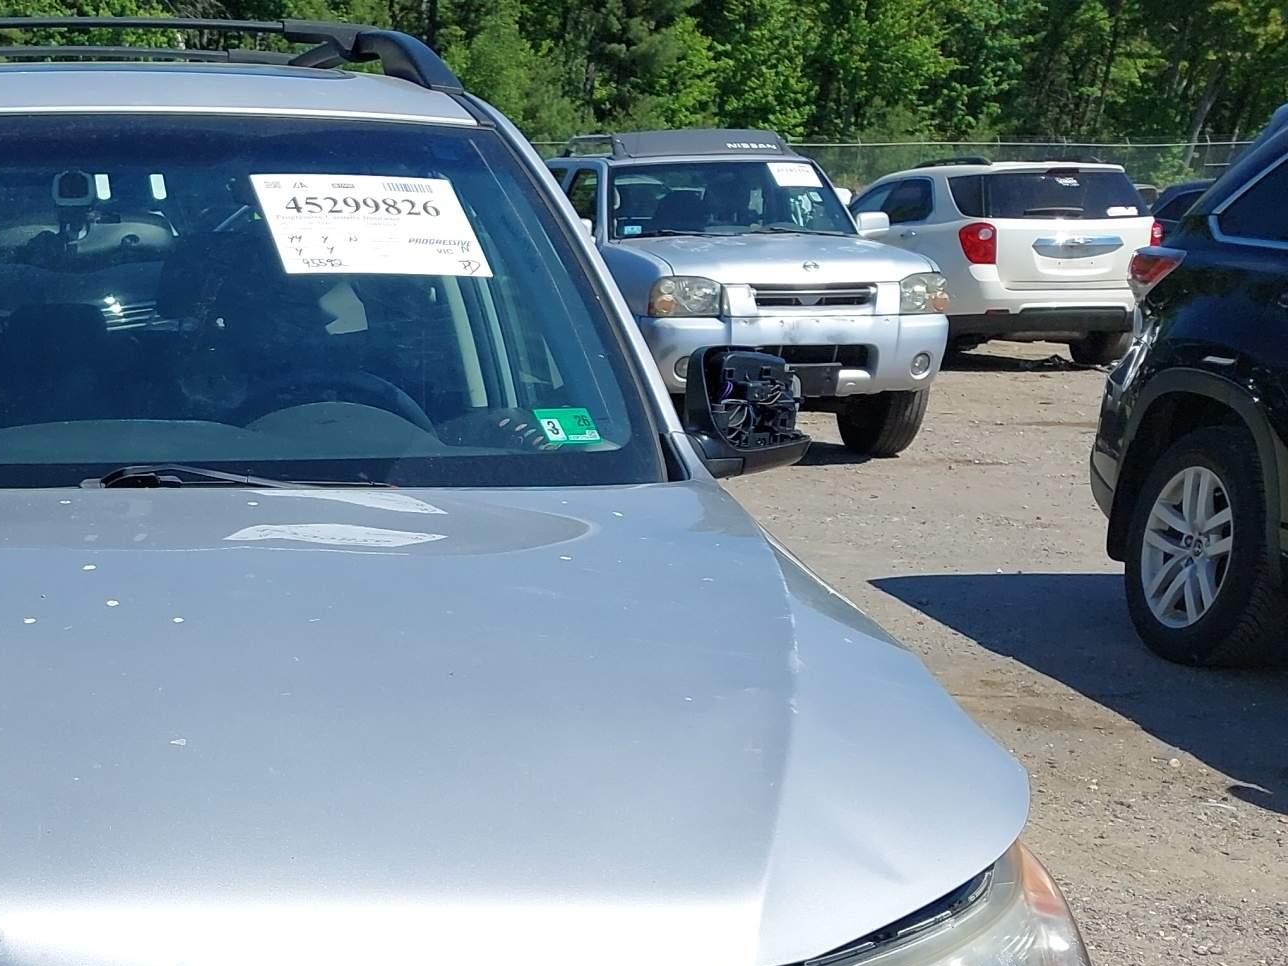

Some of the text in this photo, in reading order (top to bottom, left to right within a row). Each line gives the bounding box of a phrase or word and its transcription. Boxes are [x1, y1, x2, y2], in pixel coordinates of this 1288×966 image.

[725, 142, 777, 150] NISSAN
[284, 195, 441, 217] 45299826
[407, 237, 472, 246] PROGRESSIVE
[574, 415, 591, 427] 26
[546, 420, 560, 436] 3
